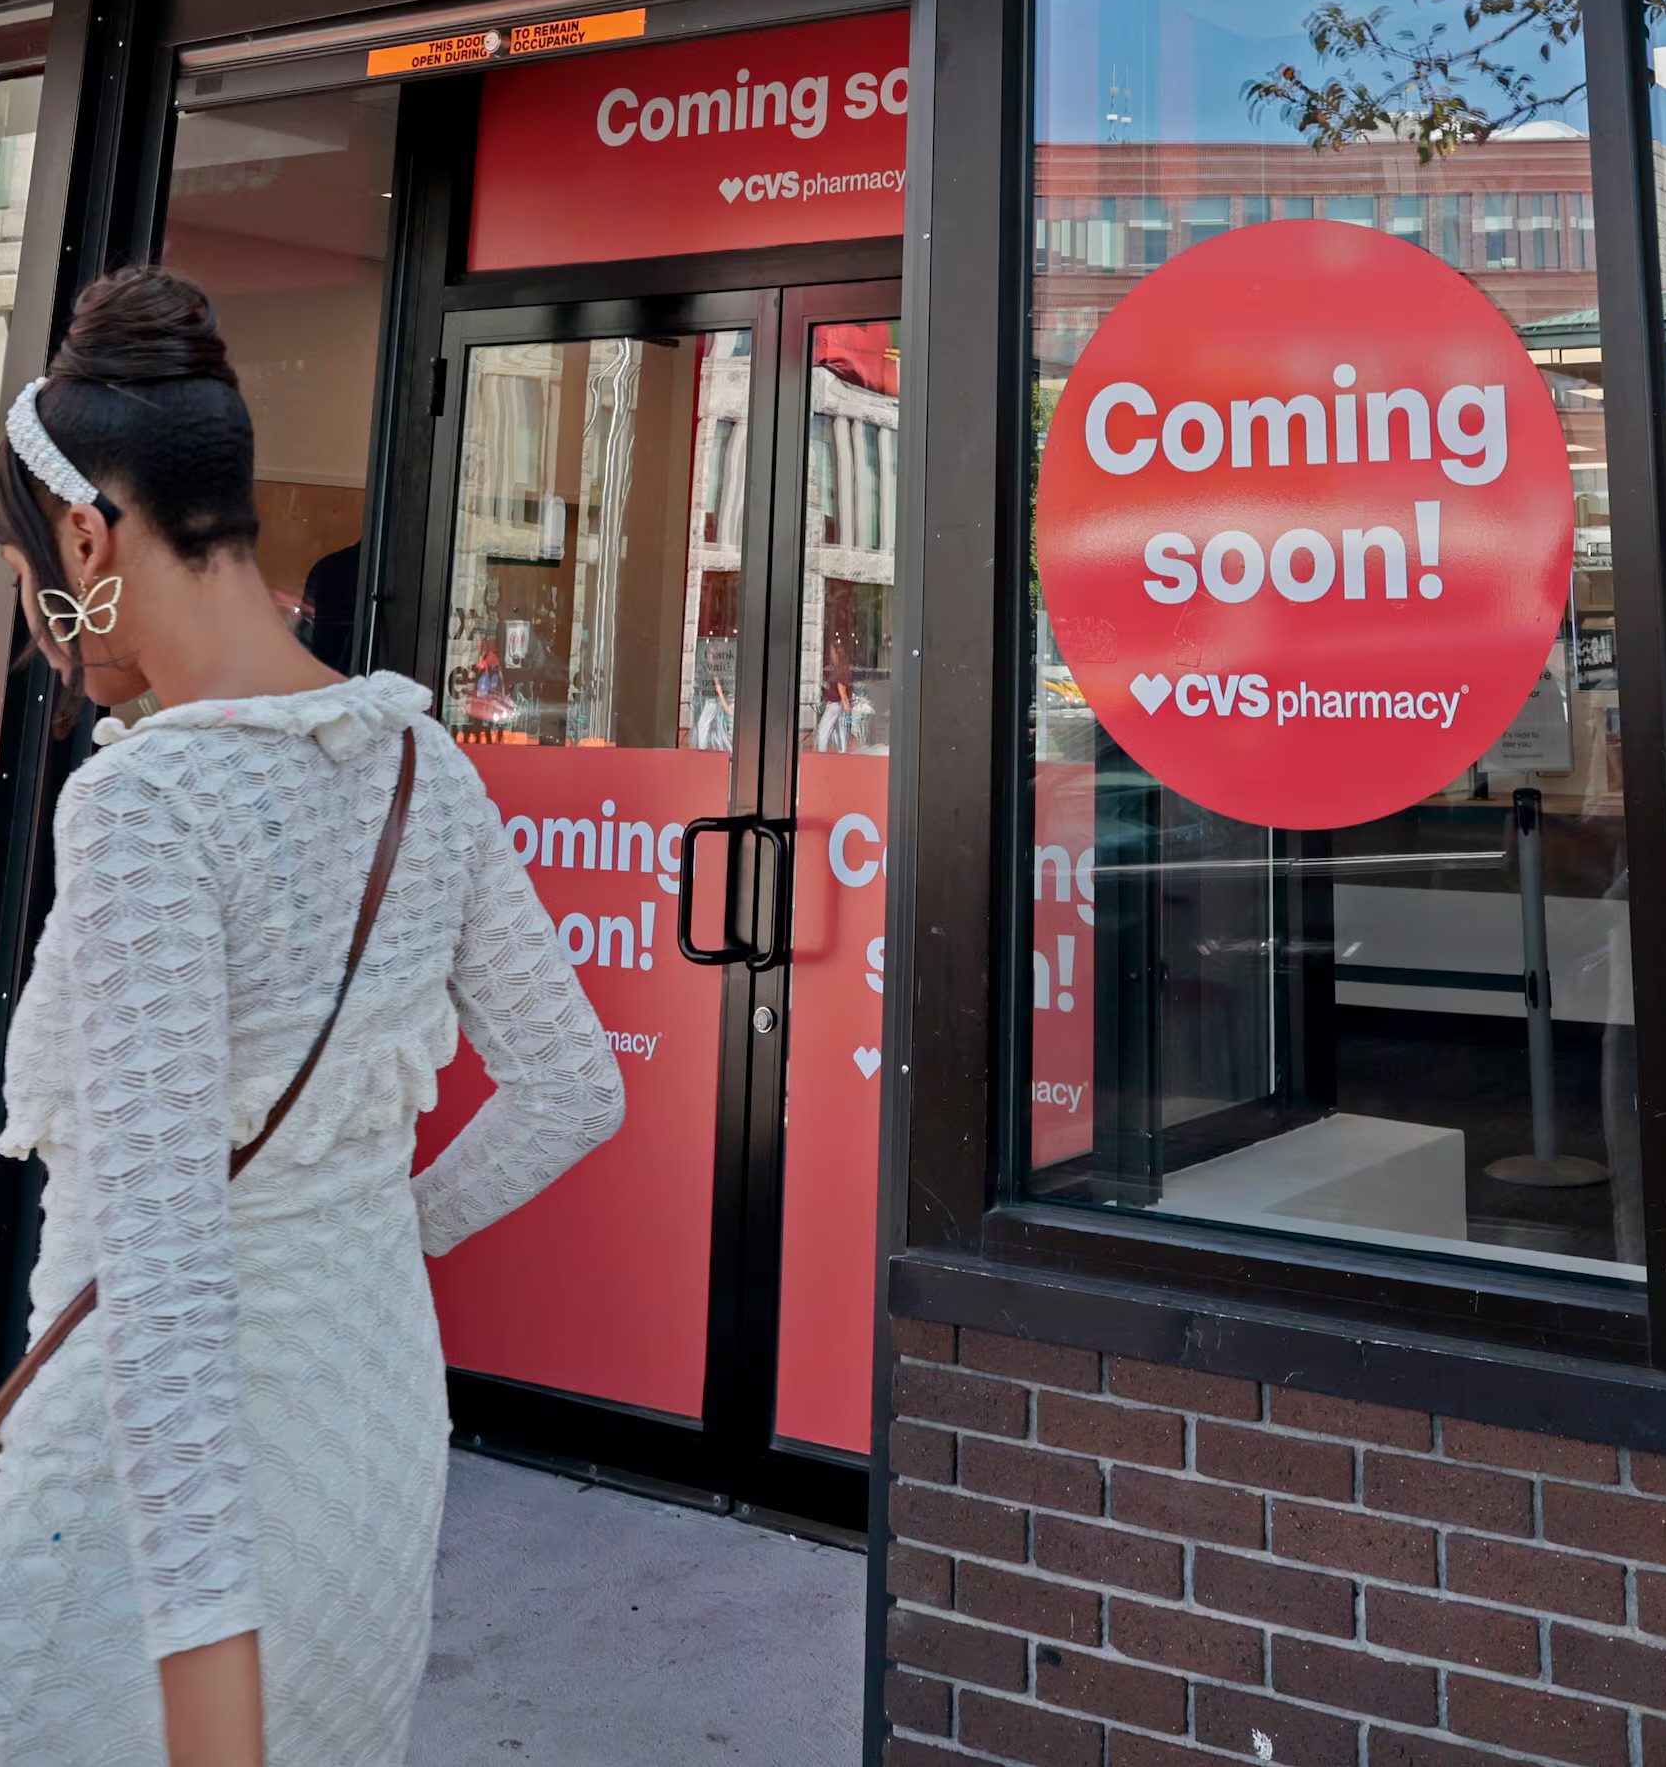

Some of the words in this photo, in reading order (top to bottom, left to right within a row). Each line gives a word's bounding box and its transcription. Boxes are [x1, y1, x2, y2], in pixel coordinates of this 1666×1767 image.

[411, 55, 441, 68] OPEN
[444, 47, 488, 64] DURING
[512, 31, 586, 52] OCCUPANCY
[428, 41, 454, 54] THIS
[514, 29, 531, 41] TO
[532, 20, 580, 38] REMAIN
[596, 68, 829, 148] Coming
[744, 170, 800, 203] CVS
[801, 168, 907, 202] pharmacy
[1084, 363, 1509, 486] Coming
[1143, 501, 1444, 605] soon!
[1174, 673, 1270, 718] CVS
[1277, 684, 1461, 728] pharmacy
[501, 799, 693, 895] oming
[557, 901, 656, 971] on!
